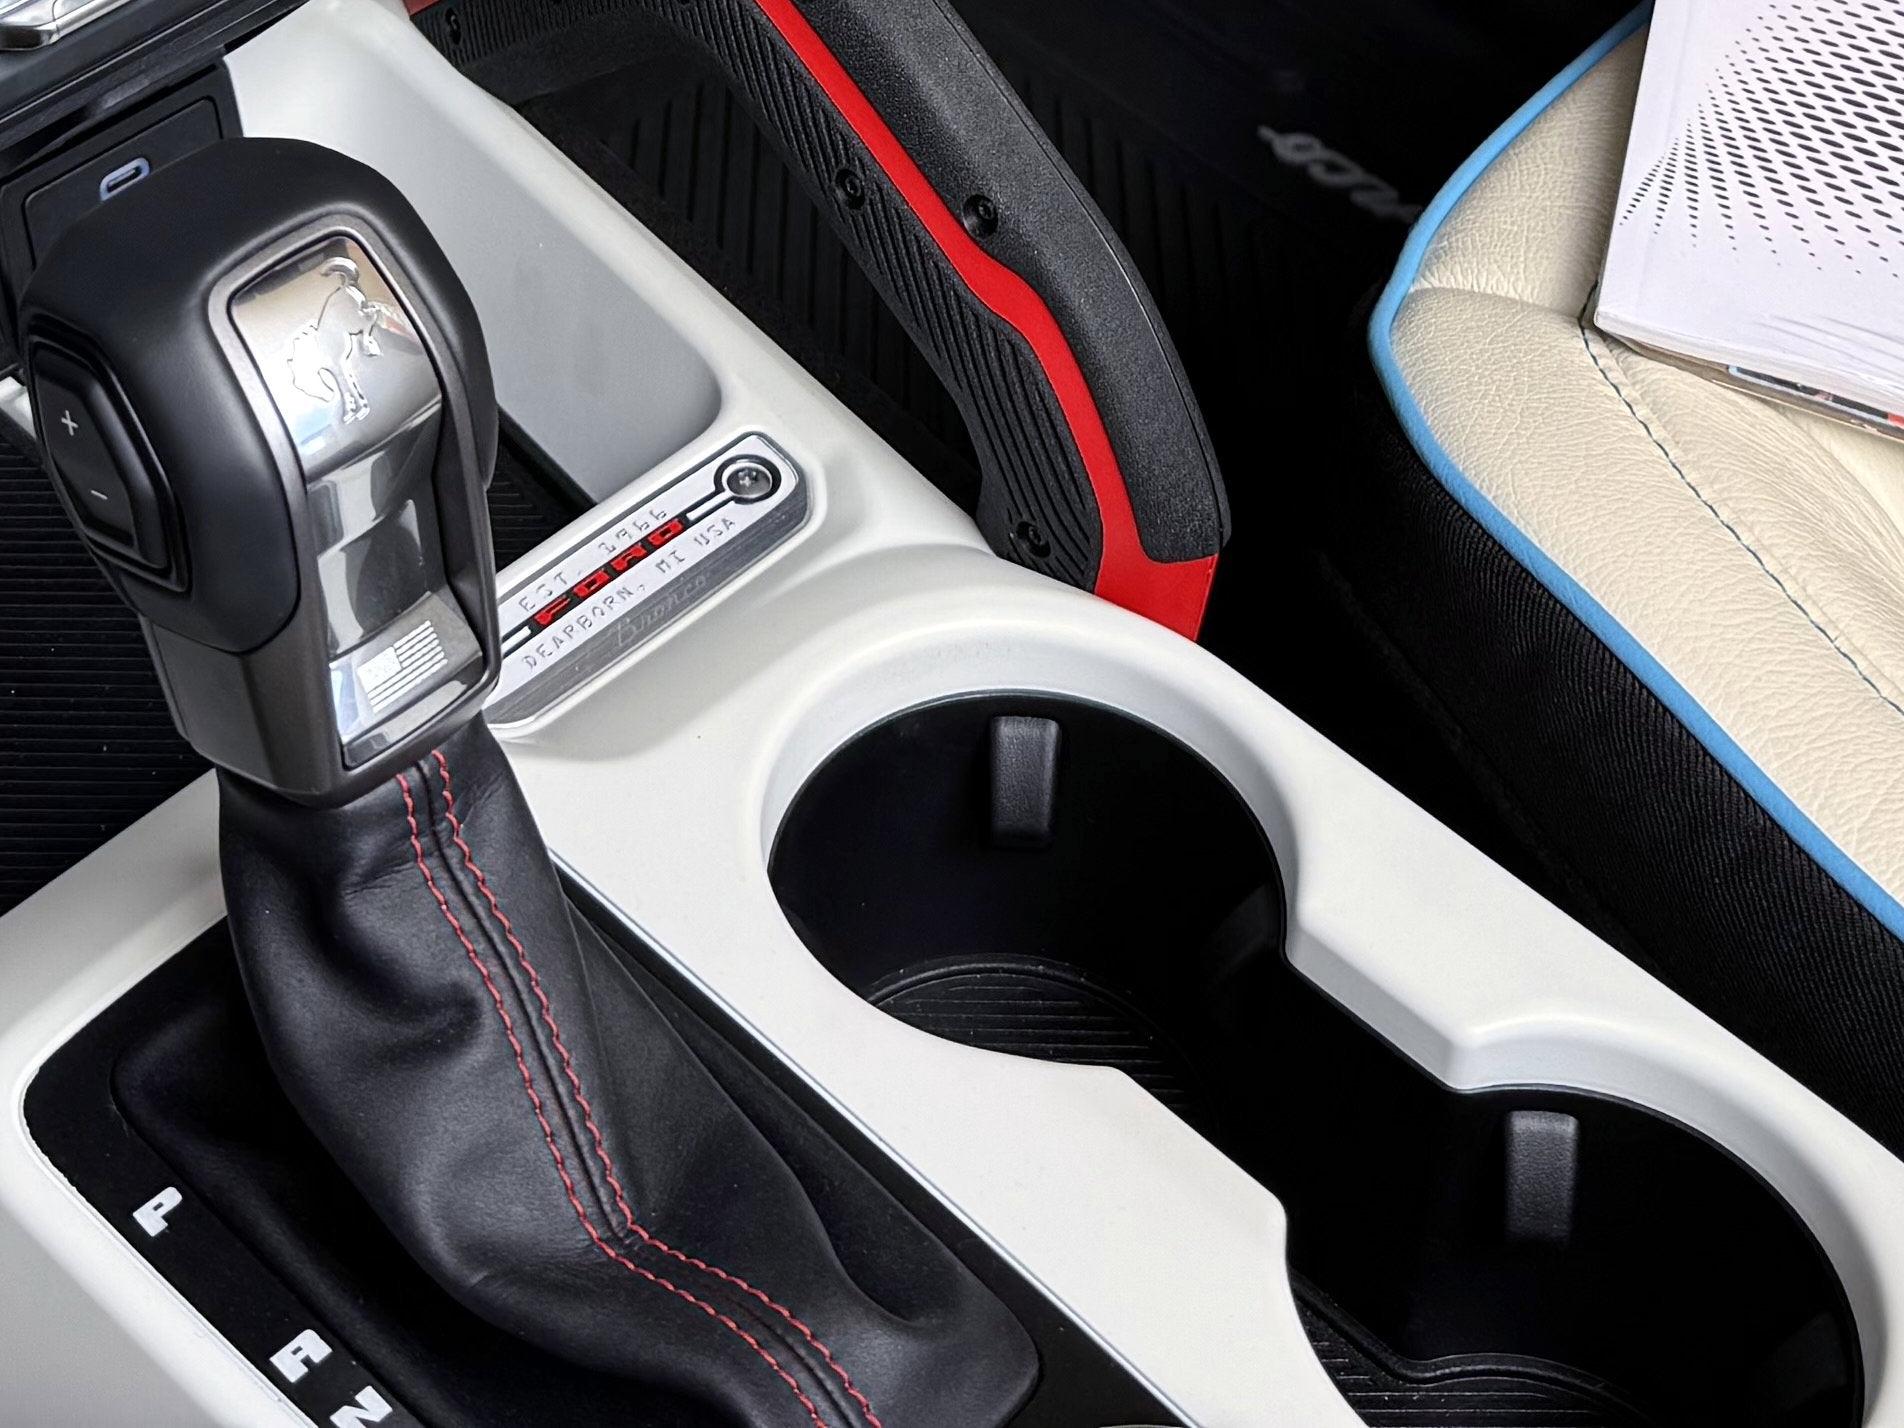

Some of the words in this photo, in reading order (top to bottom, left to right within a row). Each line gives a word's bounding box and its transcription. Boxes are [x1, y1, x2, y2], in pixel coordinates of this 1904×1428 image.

[518, 570, 584, 613] EST.
[520, 583, 647, 670] DEARBORN,
[654, 550, 686, 575] MI
[693, 517, 737, 547] USA
[533, 517, 685, 627] FORD
[132, 1186, 183, 1237] P
[269, 1329, 333, 1384] R
[329, 1385, 394, 1428] N
